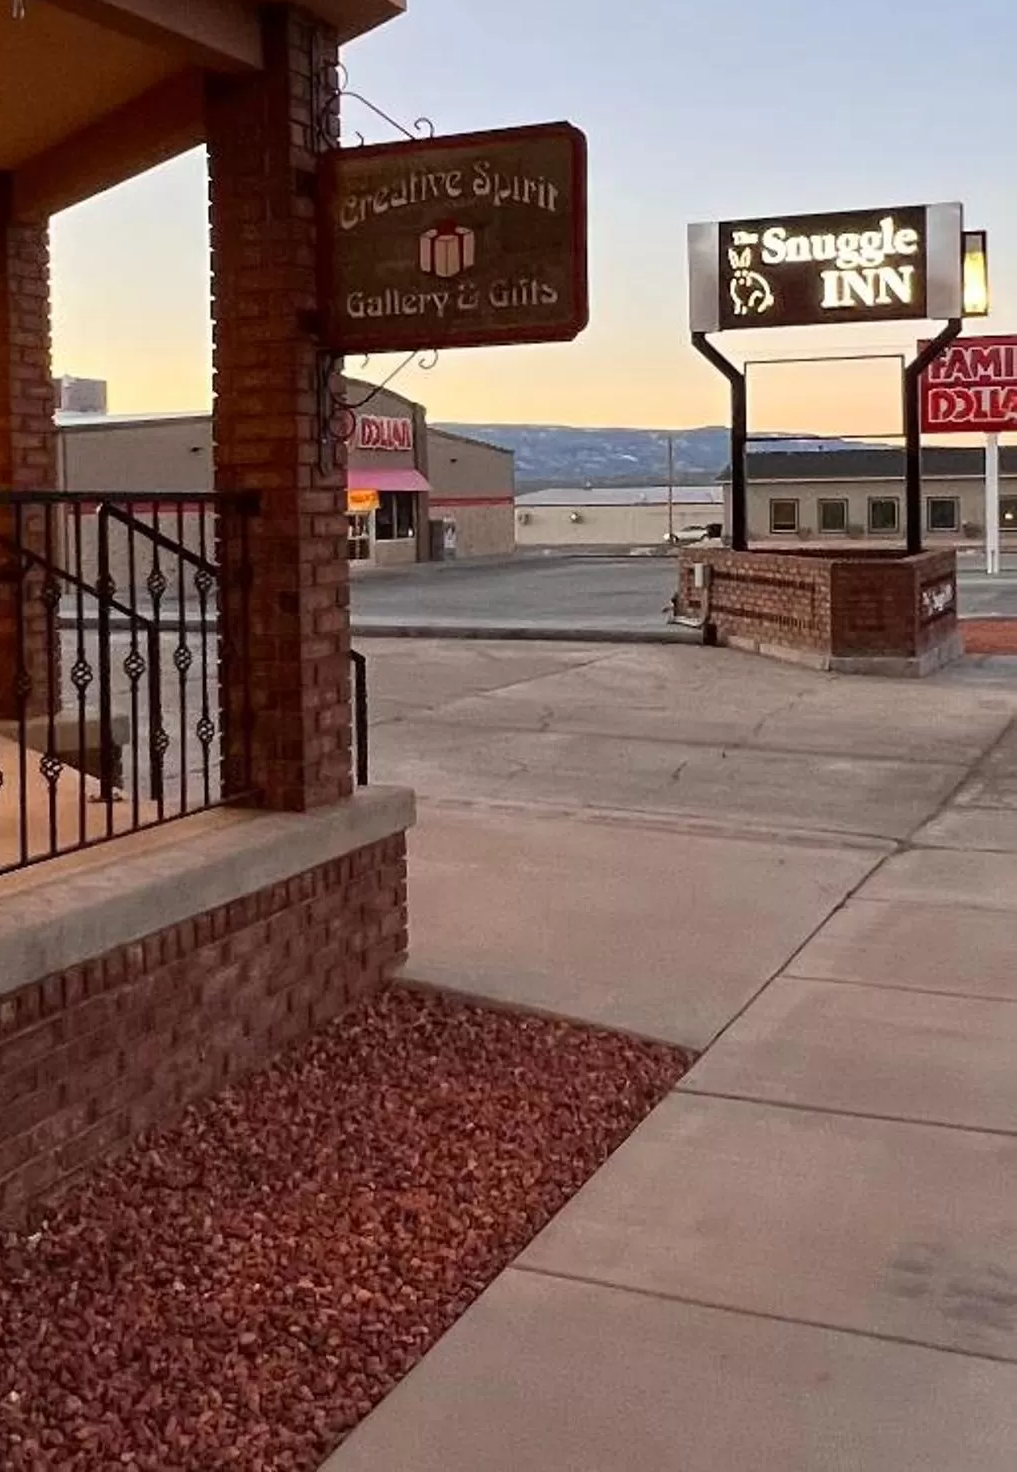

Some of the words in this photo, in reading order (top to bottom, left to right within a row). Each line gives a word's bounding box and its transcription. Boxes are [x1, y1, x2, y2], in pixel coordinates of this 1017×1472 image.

[340, 167, 462, 230] Creative
[472, 160, 559, 212] Spirit
[761, 217, 918, 268] Snuggle
[346, 288, 449, 318] Gallery
[457, 283, 479, 309] &
[489, 279, 558, 307] Gifts
[820, 266, 914, 308] INN
